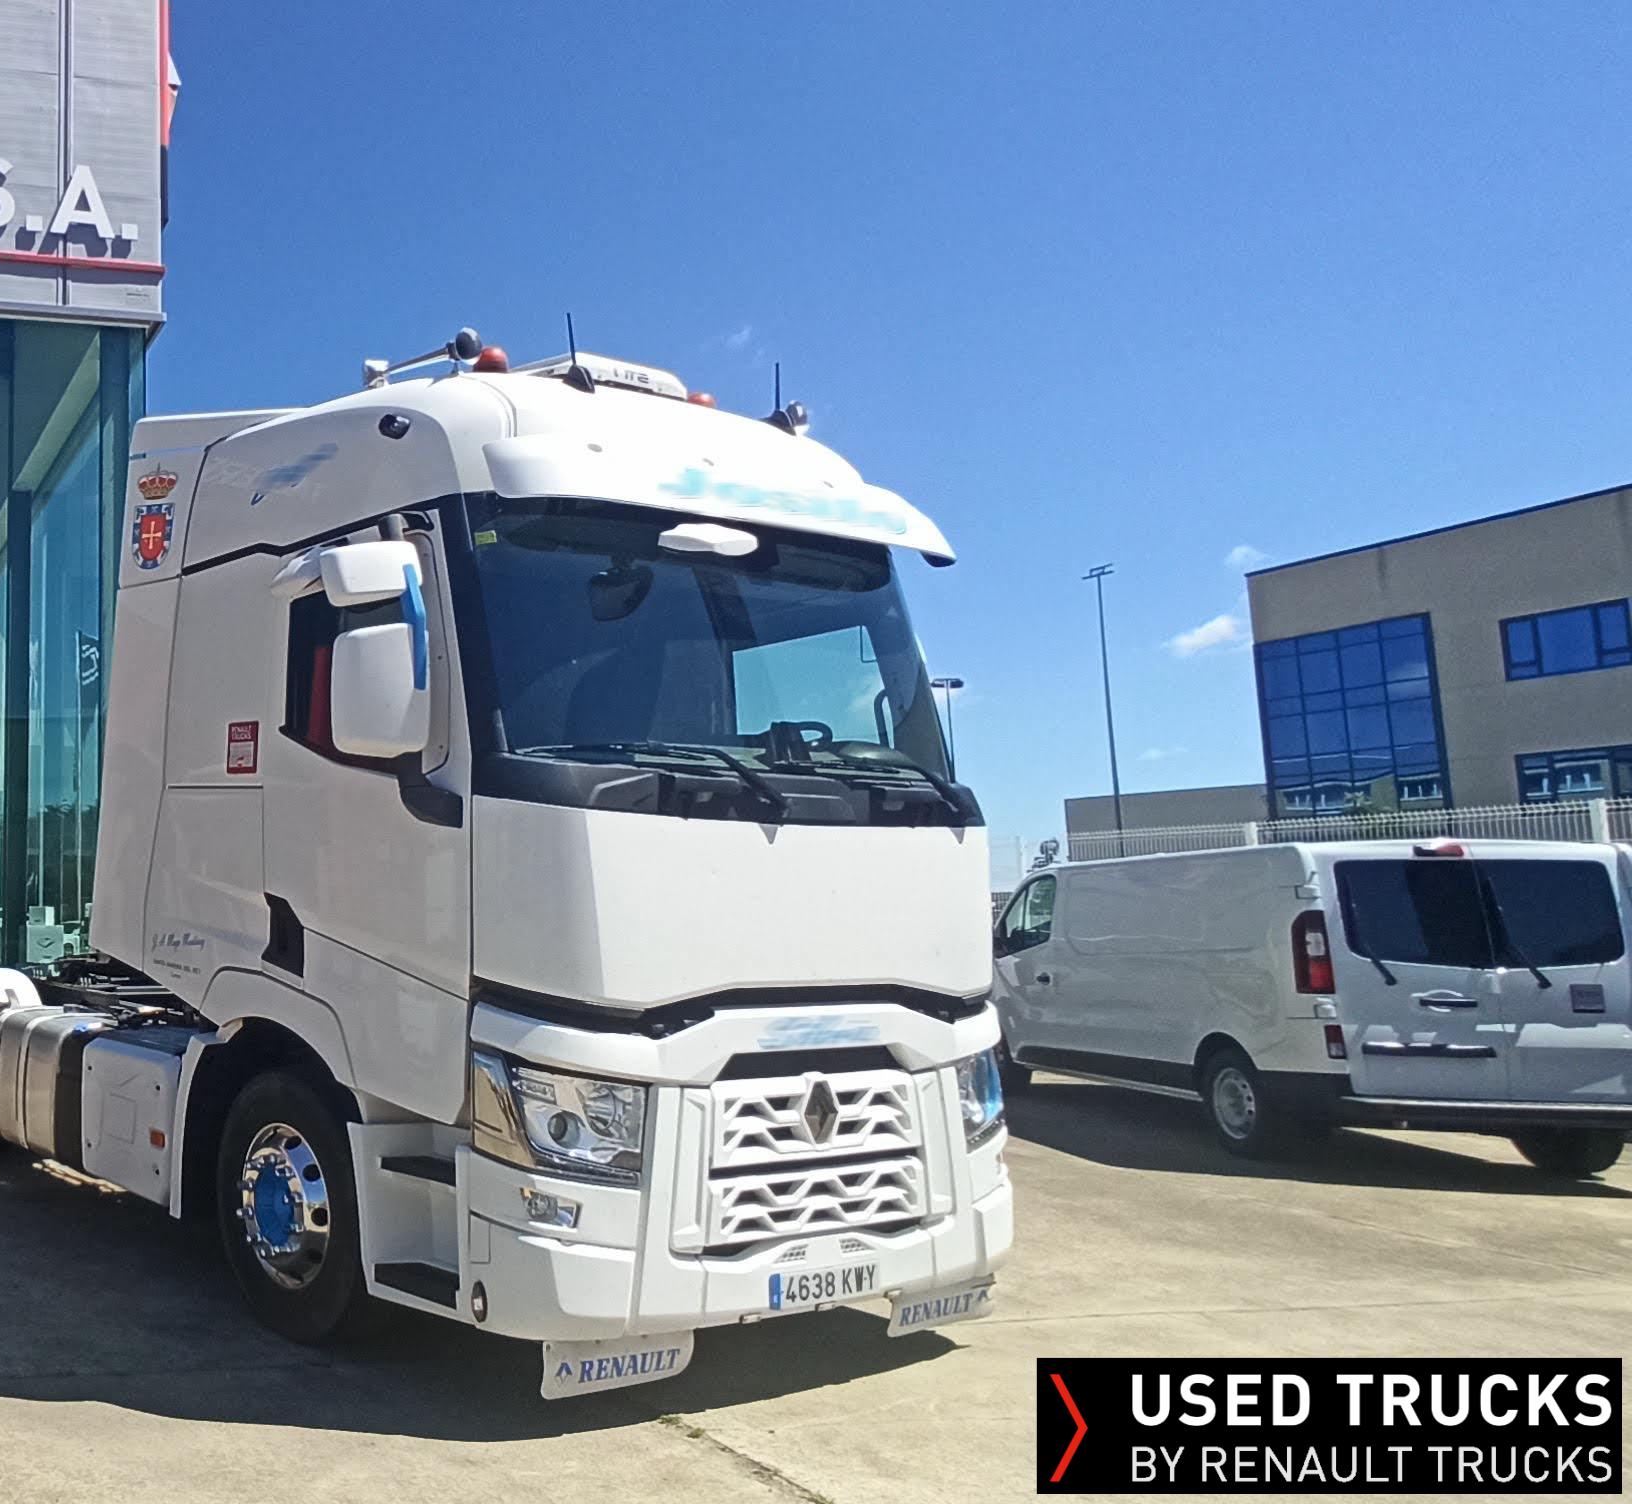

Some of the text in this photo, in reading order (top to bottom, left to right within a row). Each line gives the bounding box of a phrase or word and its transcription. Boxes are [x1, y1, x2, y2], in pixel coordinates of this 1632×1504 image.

[784, 1263, 877, 1304] 4638 KWY
[898, 1292, 974, 1327] RENAULT
[578, 1348, 681, 1384] RENAULT
